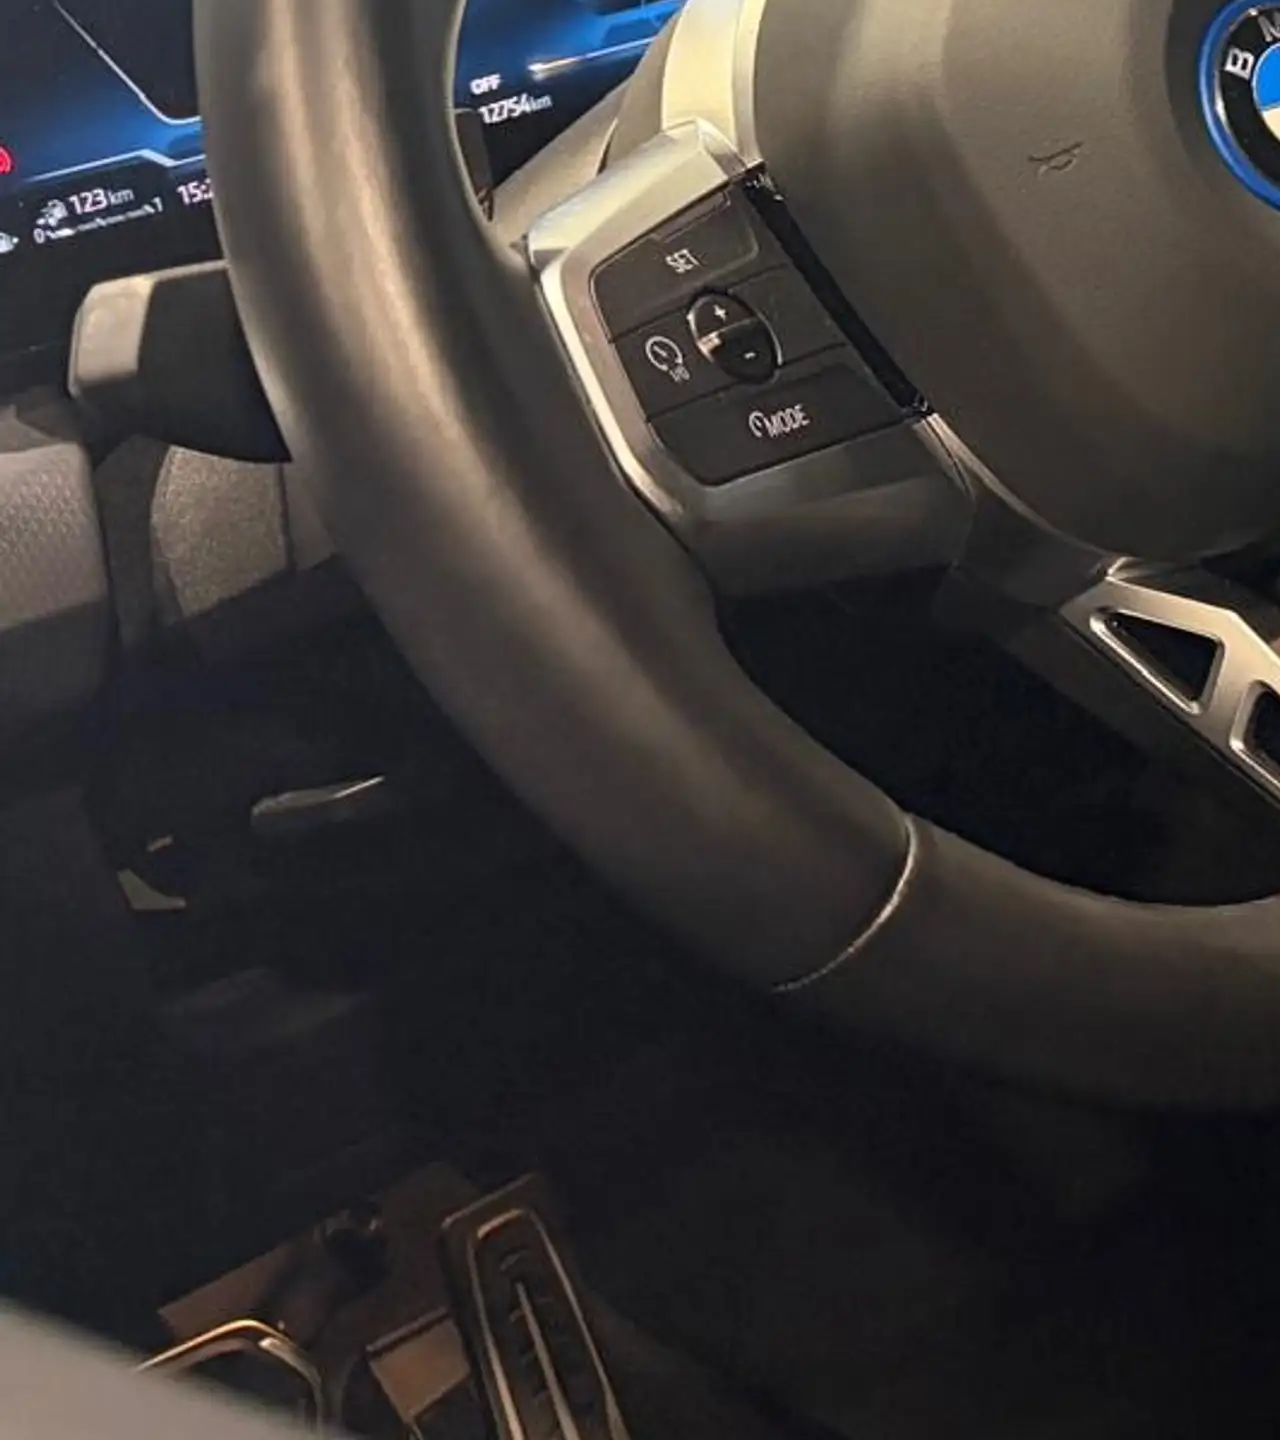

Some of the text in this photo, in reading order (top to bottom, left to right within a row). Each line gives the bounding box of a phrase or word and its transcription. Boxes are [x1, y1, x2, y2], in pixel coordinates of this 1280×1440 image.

[470, 72, 501, 95] OFF
[665, 248, 700, 274] SET
[764, 404, 812, 438] MODE
